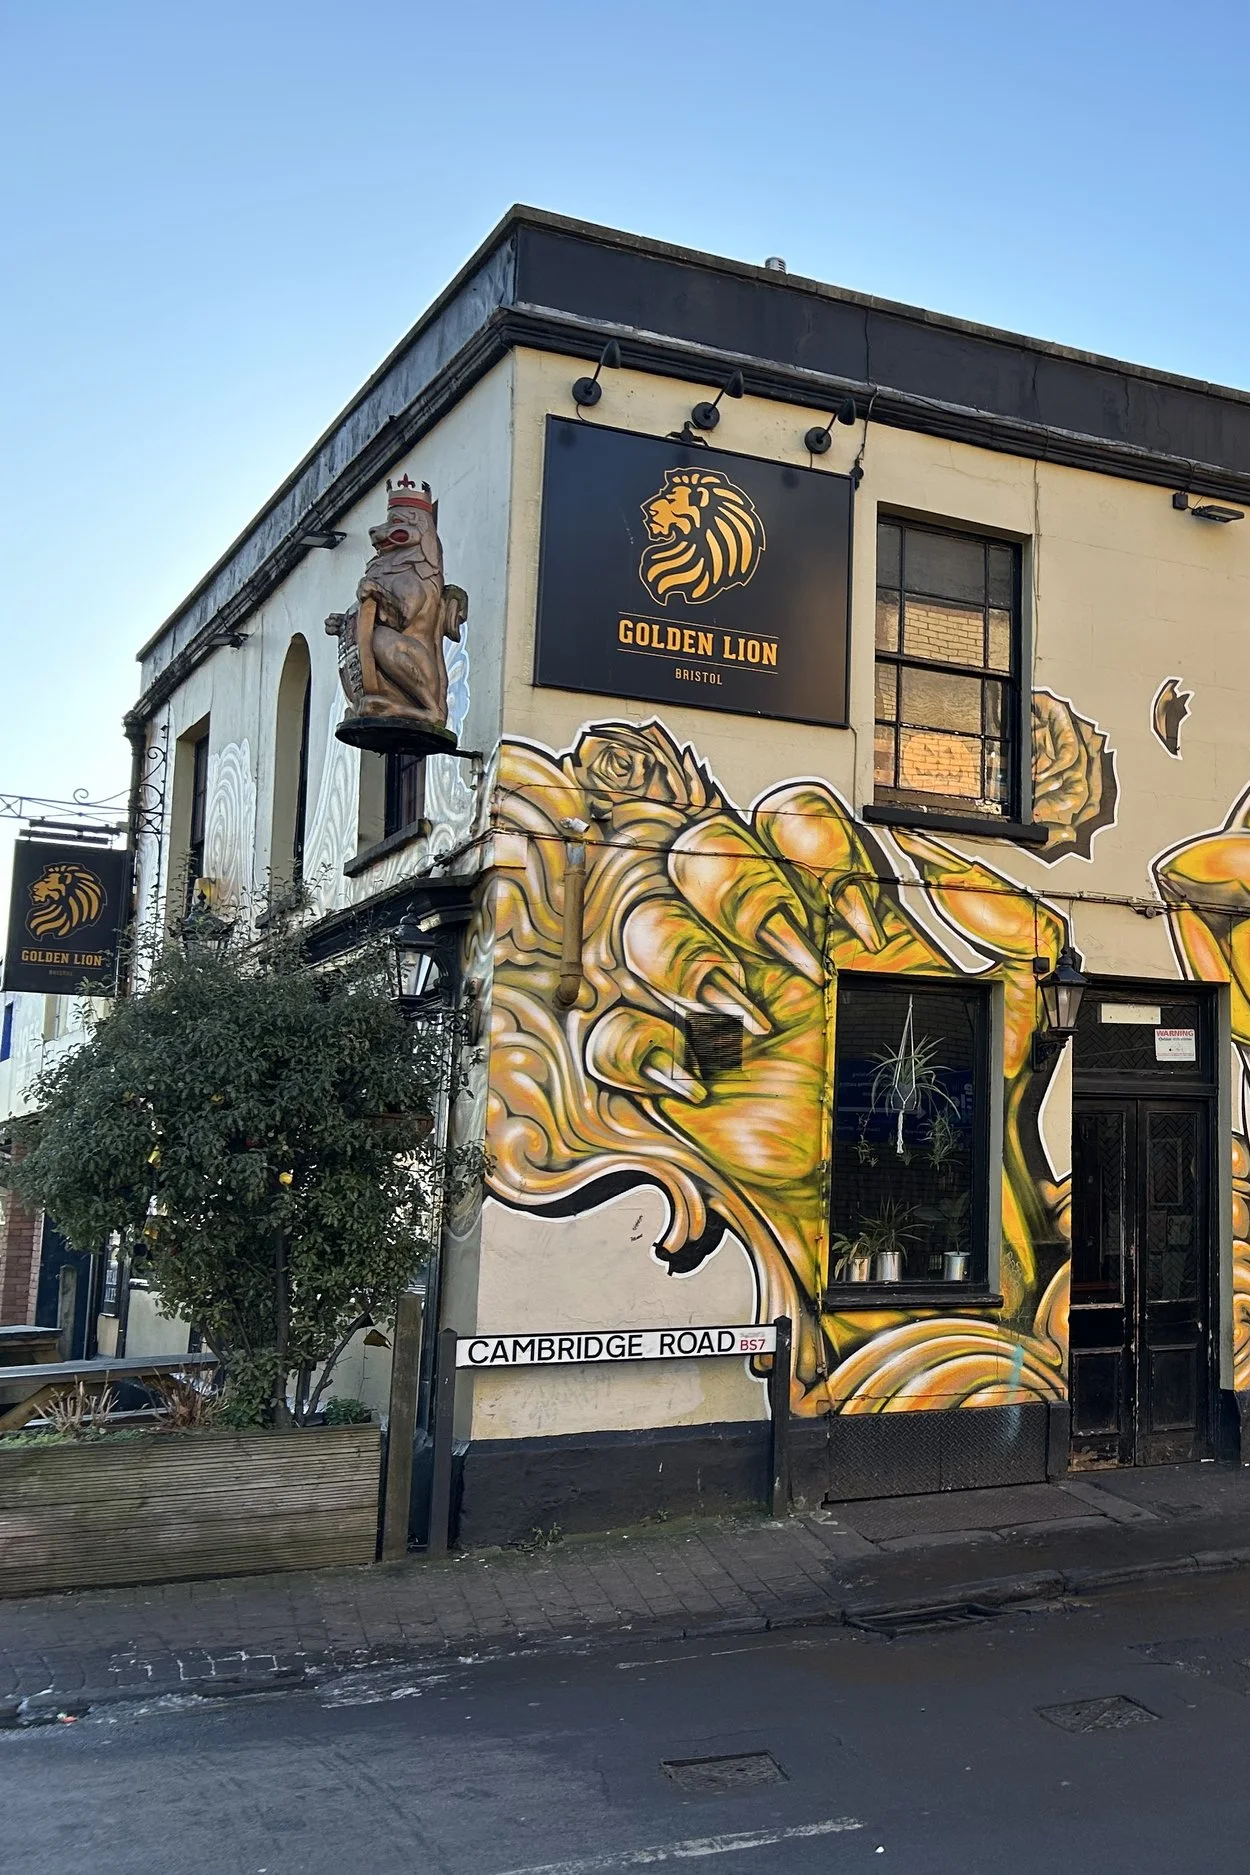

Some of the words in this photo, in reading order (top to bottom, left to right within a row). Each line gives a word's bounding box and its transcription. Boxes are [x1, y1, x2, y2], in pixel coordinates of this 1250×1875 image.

[618, 619, 713, 656] GOLDEN
[723, 636, 778, 666] LION
[675, 668, 723, 686] BRISTOL
[21, 950, 69, 964] GOLDEN
[74, 954, 102, 966] LION
[468, 1334, 643, 1364] CAMBRIDGE
[660, 1330, 736, 1355] ROAD
[740, 1338, 766, 1351] BS7
